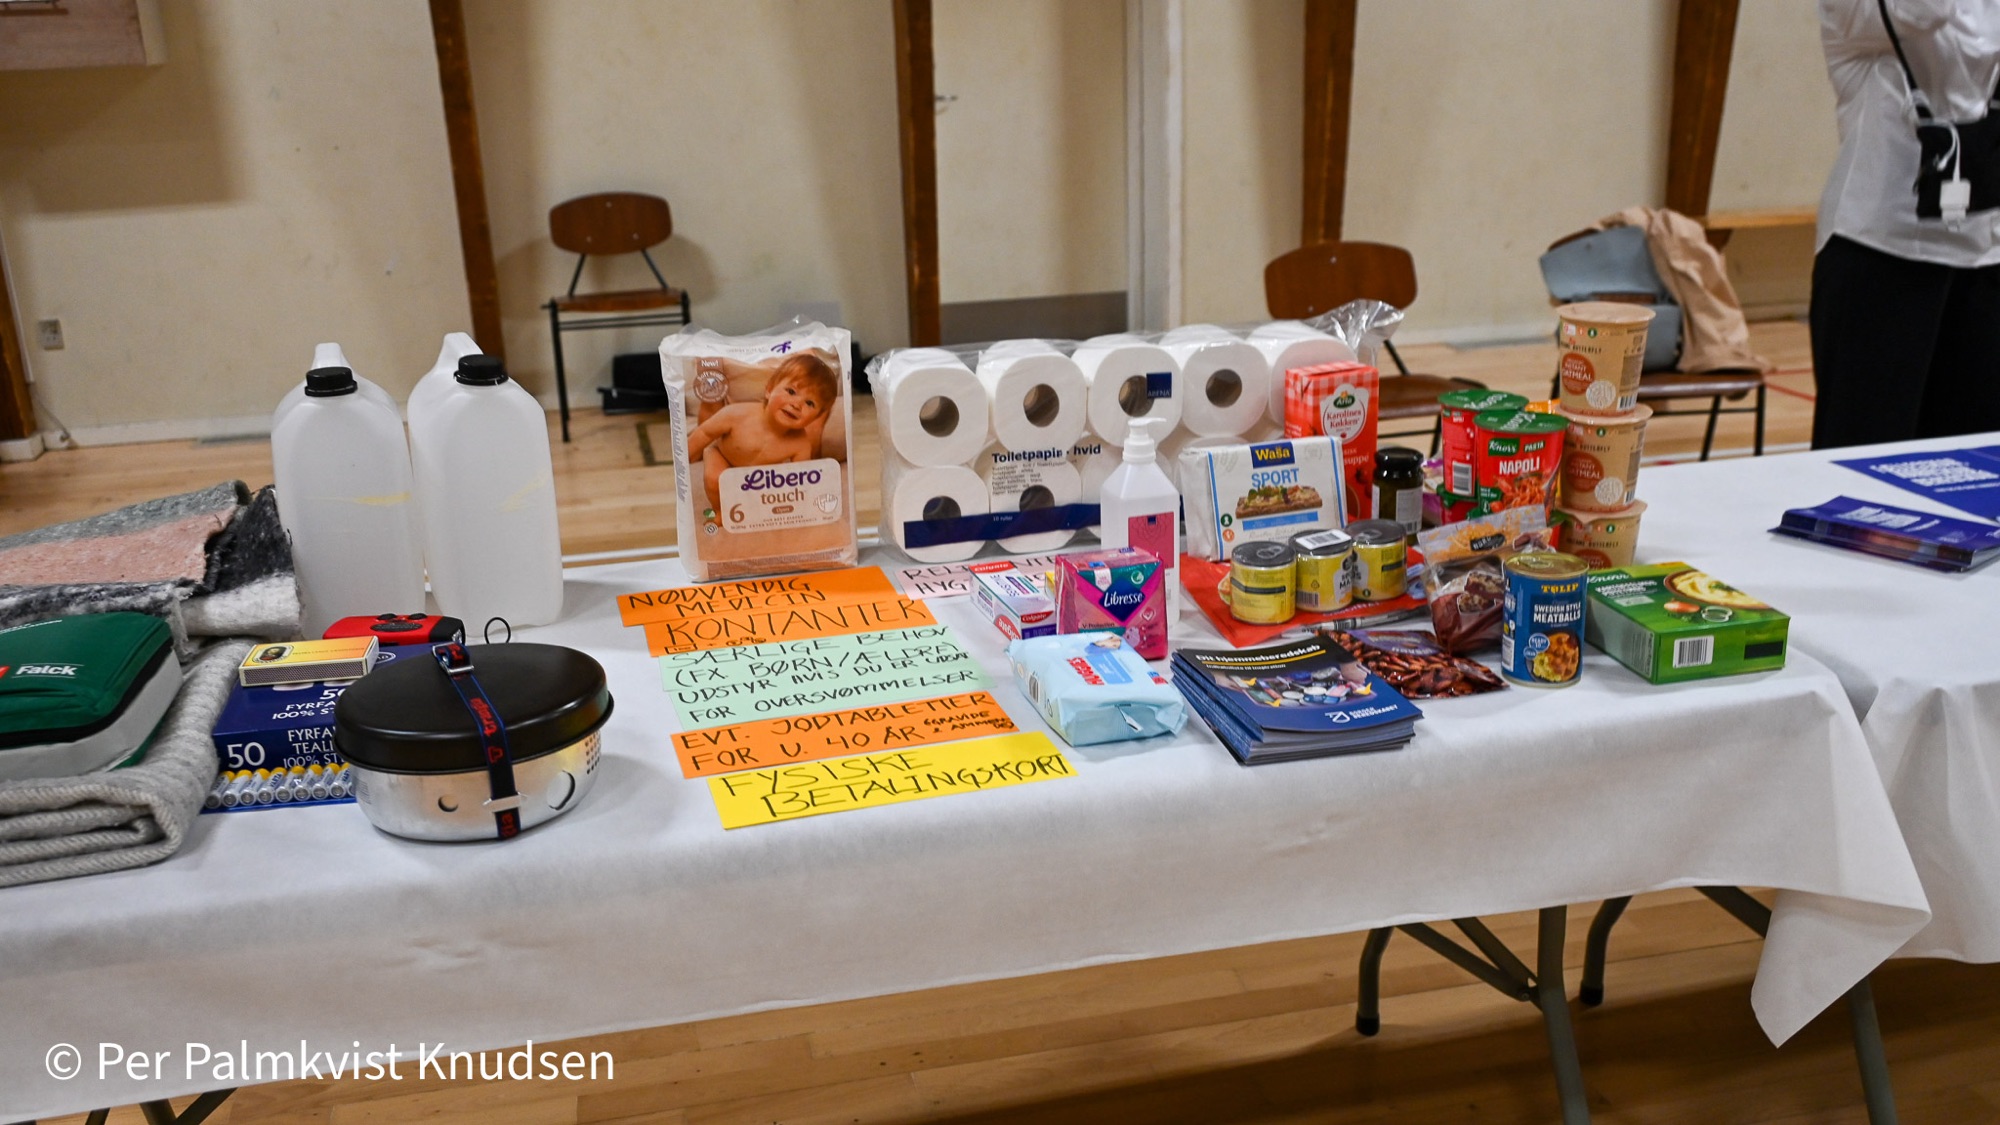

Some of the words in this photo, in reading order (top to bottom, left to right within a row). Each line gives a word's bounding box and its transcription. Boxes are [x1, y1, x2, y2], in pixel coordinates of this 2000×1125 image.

[1326, 409, 1362, 421] Karolines
[1073, 445, 1101, 456] hvid
[1489, 440, 1518, 453] Knorr
[1524, 441, 1545, 453] PASTA
[1344, 455, 1370, 465] suppe
[1499, 456, 1541, 476] NAPOLI
[741, 469, 821, 491] Libero
[1251, 468, 1300, 488] SPORT
[761, 488, 805, 505] touch
[729, 503, 745, 523] 6
[629, 578, 811, 609] NØDVENDIG
[1104, 591, 1143, 607] Libresse
[1022, 612, 1047, 623] Colgate
[1533, 610, 1581, 623] MEATBALLS
[1534, 604, 1565, 613] SWEDISH
[666, 599, 926, 646] KONTANTER
[667, 639, 840, 668] SÆRLIGE
[857, 626, 949, 645] BEHOV
[1215, 644, 1321, 663] hjemmeberedskab
[16, 665, 78, 676] Falck
[678, 678, 778, 704] UDSTYR
[853, 663, 882, 676] DU
[891, 659, 919, 670] ER
[689, 705, 736, 723] FOR
[755, 670, 979, 712] OVERSVØMMELSER
[285, 701, 336, 711] FYRFA
[272, 711, 315, 720] 100%
[681, 726, 751, 749] EVT.
[771, 693, 996, 735] JODTABLETTER
[287, 727, 336, 742] FYRFA
[227, 741, 266, 769] 50
[292, 741, 334, 755] TEALI
[691, 747, 759, 771] FOR
[826, 732, 871, 749] 40
[883, 725, 925, 745] ÅR
[283, 755, 320, 768] 100%
[719, 751, 933, 796] FYSISKE
[760, 753, 1069, 818] BETALINGSKORT
